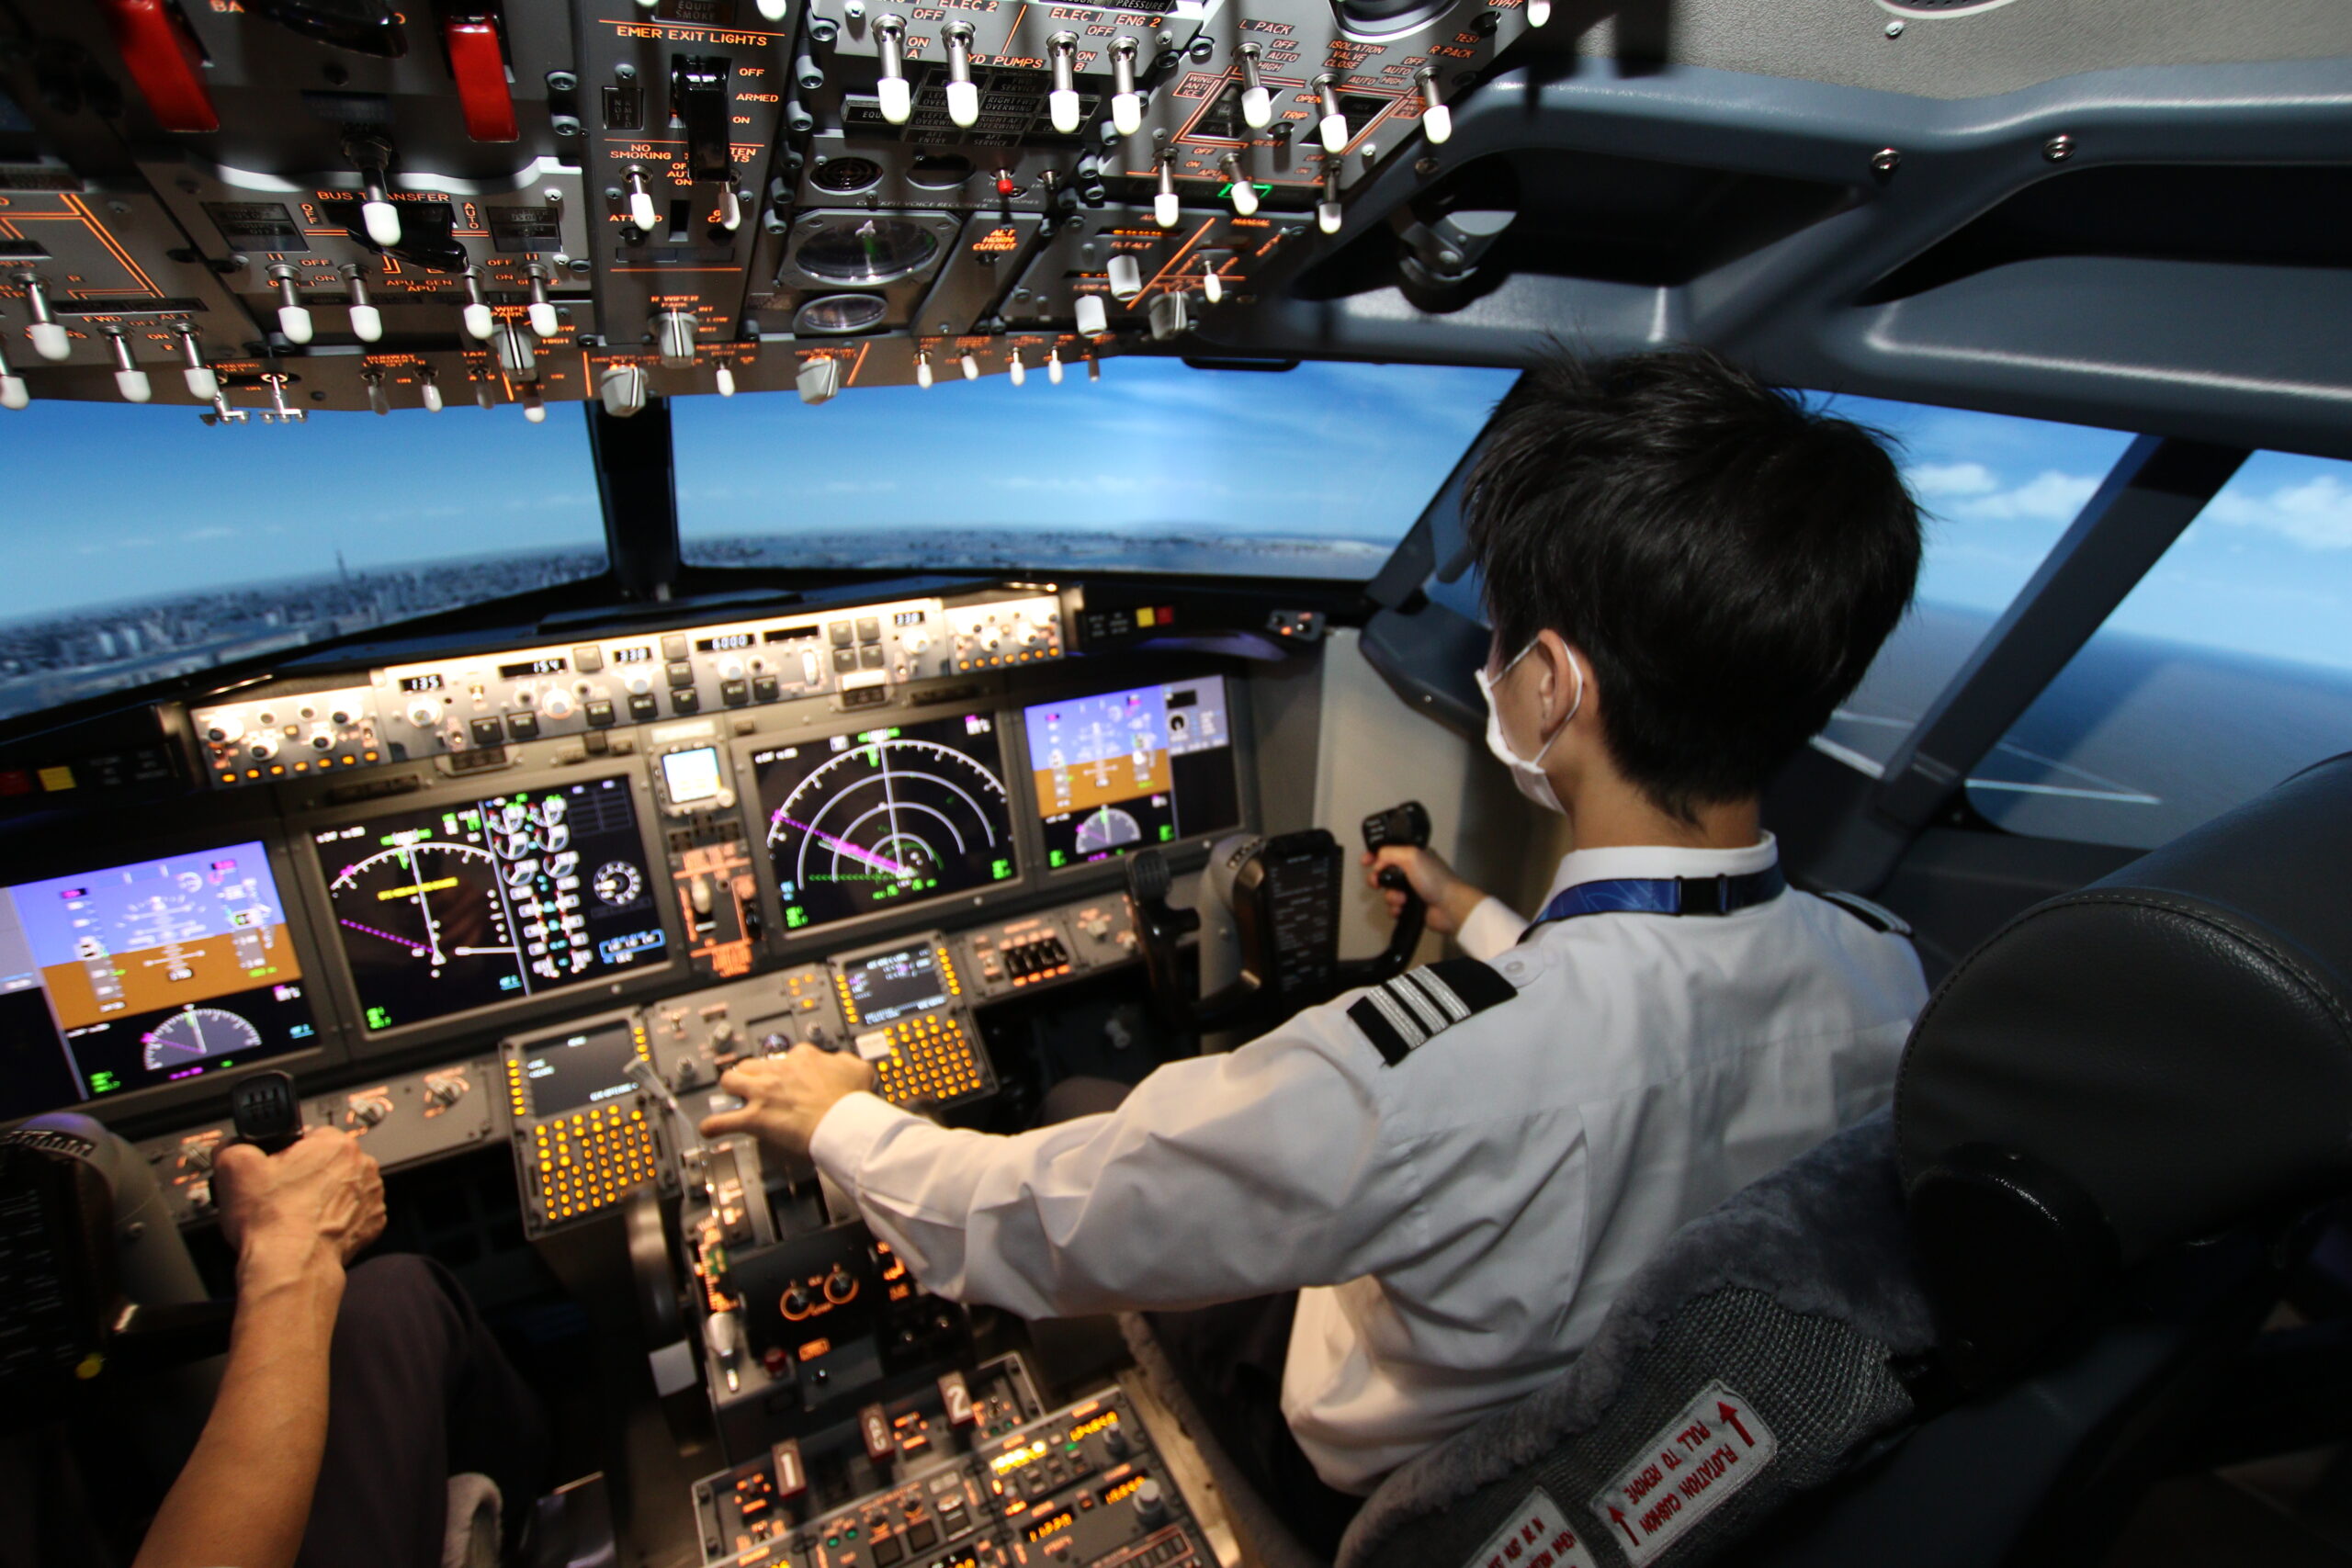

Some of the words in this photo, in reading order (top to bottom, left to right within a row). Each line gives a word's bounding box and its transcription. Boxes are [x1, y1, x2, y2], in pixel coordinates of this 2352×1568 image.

[986, 1, 998, 12] 2
[913, 9, 944, 21] OFF
[1050, 7, 1091, 21] ELEC
[1115, 14, 1146, 27] ENG
[1149, 17, 1162, 28] 2
[1087, 26, 1114, 37] OFF
[1238, 19, 1248, 29] L
[1254, 21, 1294, 35] PACK
[616, 26, 662, 39] EMER
[668, 29, 705, 42] EXIT
[710, 33, 767, 46] LIGHTS
[1455, 33, 1479, 43] TEST
[908, 37, 930, 47] ON
[1272, 39, 1296, 50] OFF
[1329, 40, 1385, 54] ISOLATION
[906, 50, 919, 59] A
[1076, 52, 1097, 62] ON
[1266, 52, 1298, 62] AUTO
[1332, 51, 1366, 61] VALVE
[1429, 45, 1441, 54] R
[1441, 46, 1476, 59] PACK
[967, 53, 986, 64] YD
[992, 56, 1045, 69] PUMPS
[1323, 60, 1359, 70] CLOSE
[1073, 62, 1085, 72] B
[1258, 62, 1283, 72] HIGH
[1383, 66, 1412, 74] AUTO
[739, 68, 765, 77] OFF
[1189, 75, 1215, 84] WING
[1348, 77, 1376, 85] AUTO
[736, 93, 779, 103] ARMED
[1295, 95, 1322, 104] OPEN
[1283, 110, 1309, 119] TRIP
[732, 116, 751, 124] ON
[630, 144, 651, 152] NO
[610, 151, 672, 160] SMOKING
[316, 190, 353, 200] BUS
[300, 203, 318, 225] OFF
[464, 202, 480, 230] AUTO
[972, 243, 1018, 251] CUTOUT
[147, 332, 170, 341] ON
[533, 660, 560, 673] 154
[412, 675, 439, 691] 135
[945, 1385, 972, 1417] 2
[1676, 1419, 1711, 1452] PULL
[1660, 1448, 1683, 1471] TO
[780, 1452, 797, 1488] 1
[1679, 1442, 1739, 1500] FLOTATION
[1623, 1462, 1663, 1506] REMOVE
[1639, 1492, 1682, 1537] CUSHION
